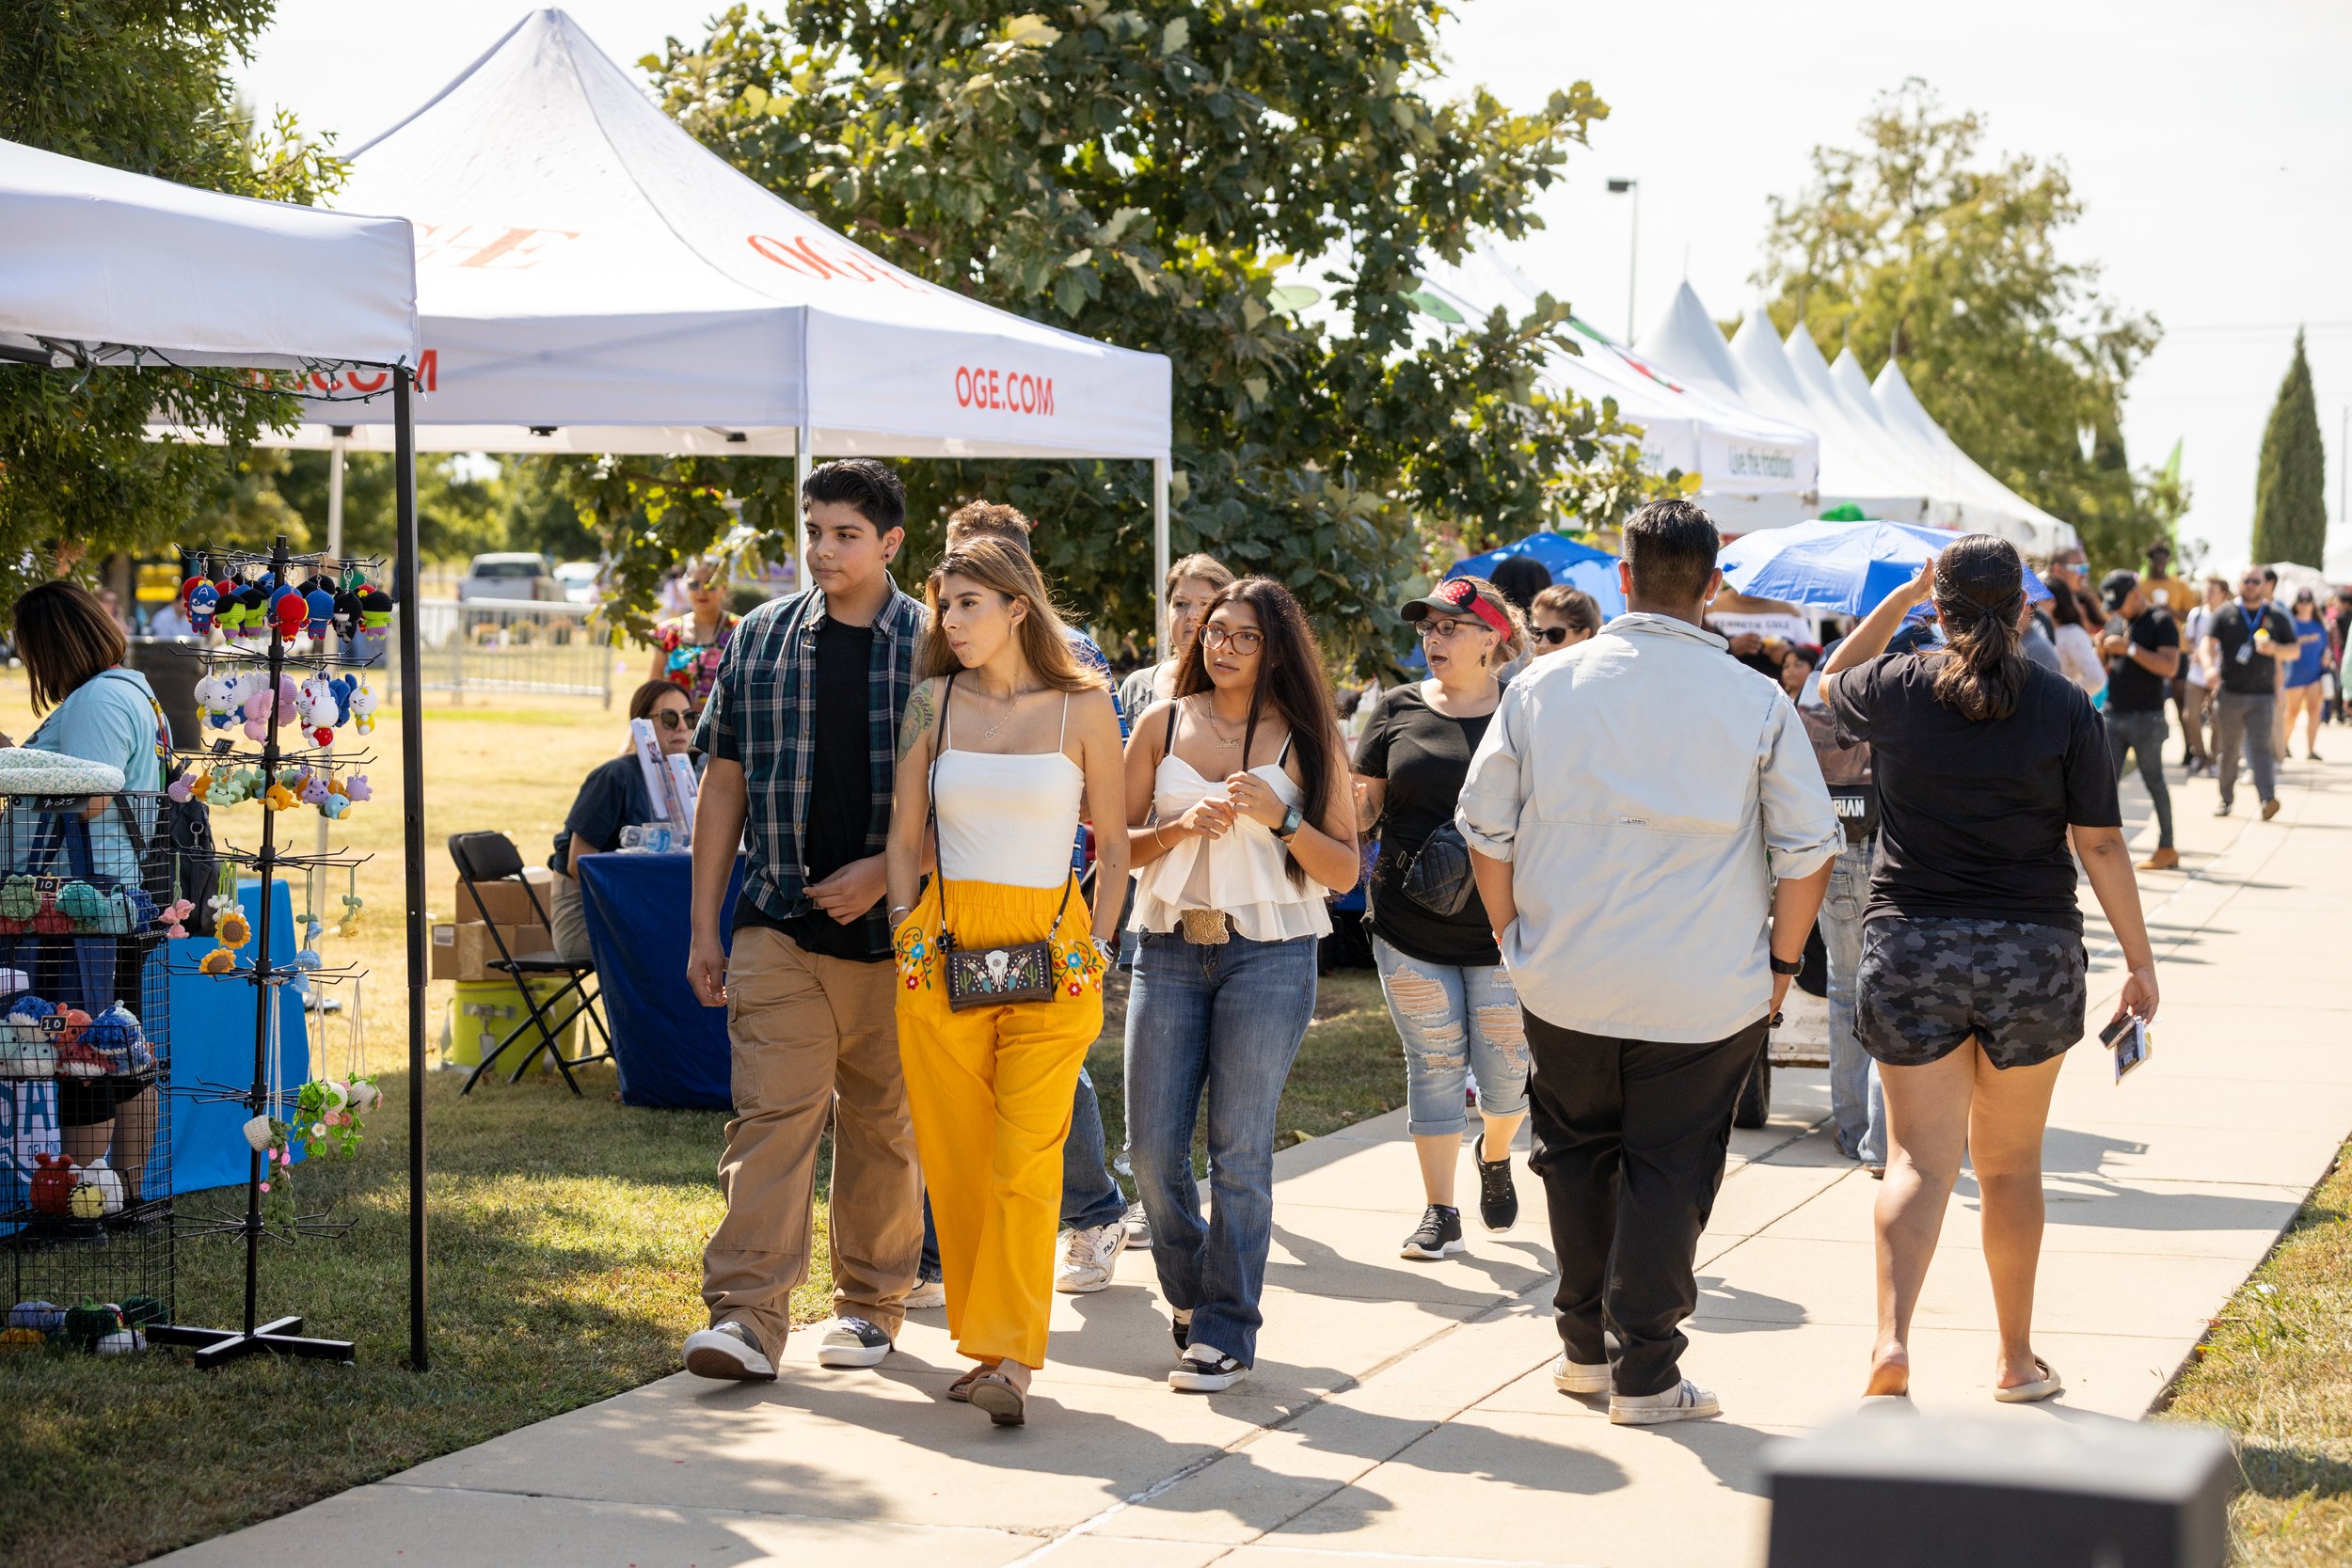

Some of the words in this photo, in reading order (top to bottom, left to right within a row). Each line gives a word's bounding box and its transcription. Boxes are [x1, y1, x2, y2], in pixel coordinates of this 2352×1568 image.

[955, 365, 1054, 417] OGE.COM
[43, 798, 75, 808] $25
[1833, 799, 1865, 817] RIAN
[40, 880, 53, 889] 10
[43, 1019, 61, 1030] 10
